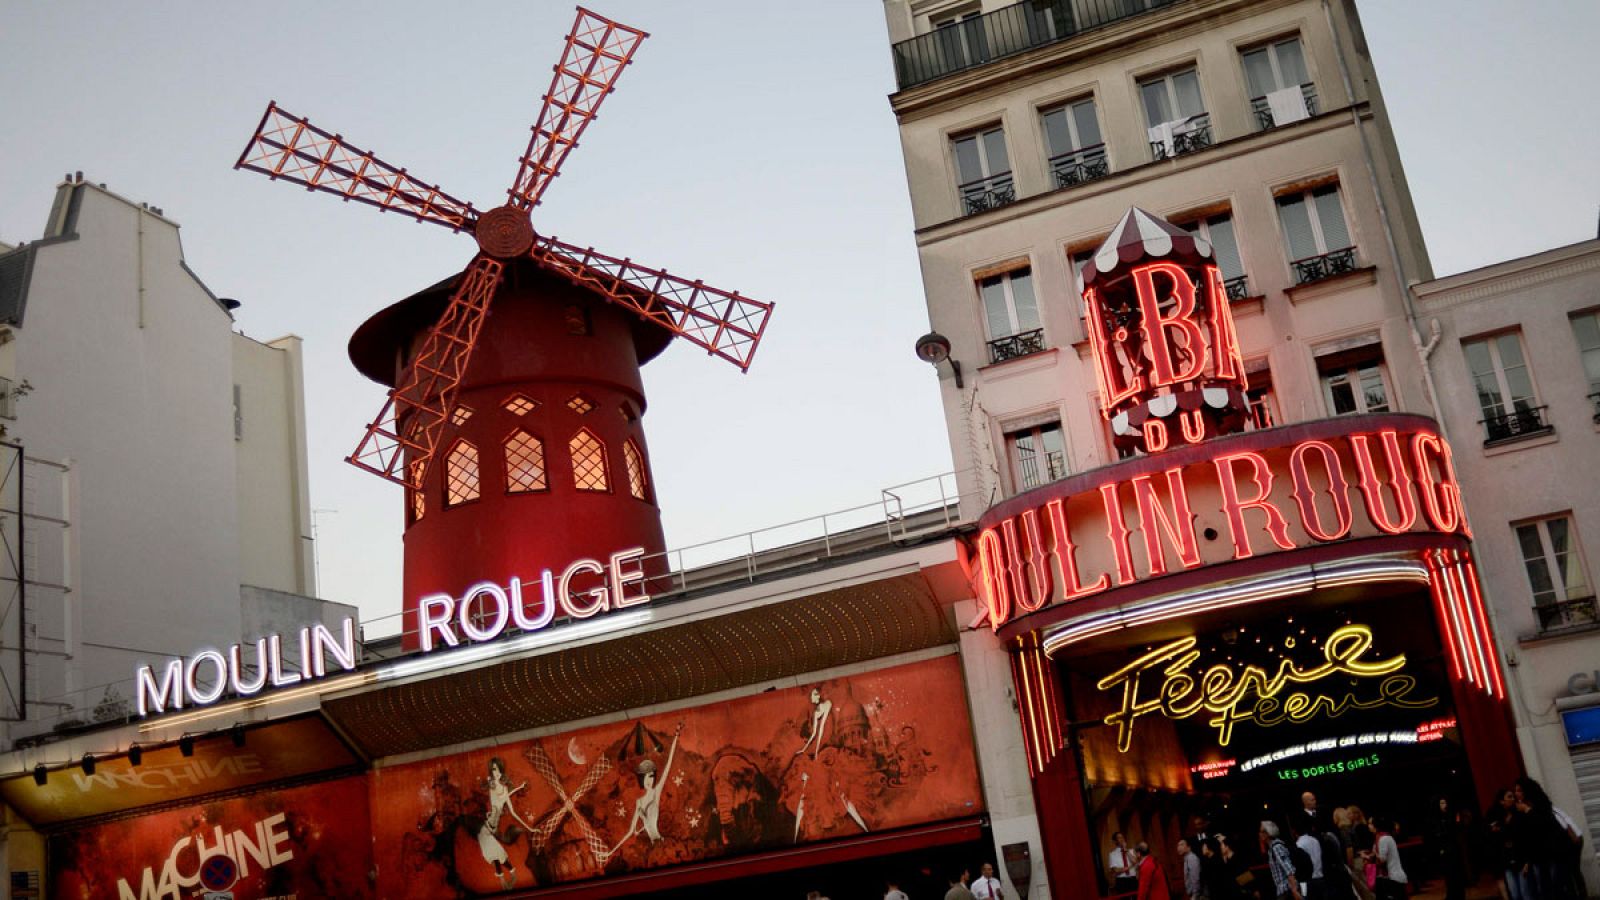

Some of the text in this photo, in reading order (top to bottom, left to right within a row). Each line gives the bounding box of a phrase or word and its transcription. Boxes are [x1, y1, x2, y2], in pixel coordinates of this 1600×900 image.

[1143, 411, 1204, 453] DU
[977, 429, 1473, 633] OULIN ROUG
[136, 546, 650, 716] MOULIN ROUGE
[1278, 754, 1380, 780] LES DORISS GIRLS
[115, 811, 295, 900] MACHINE
